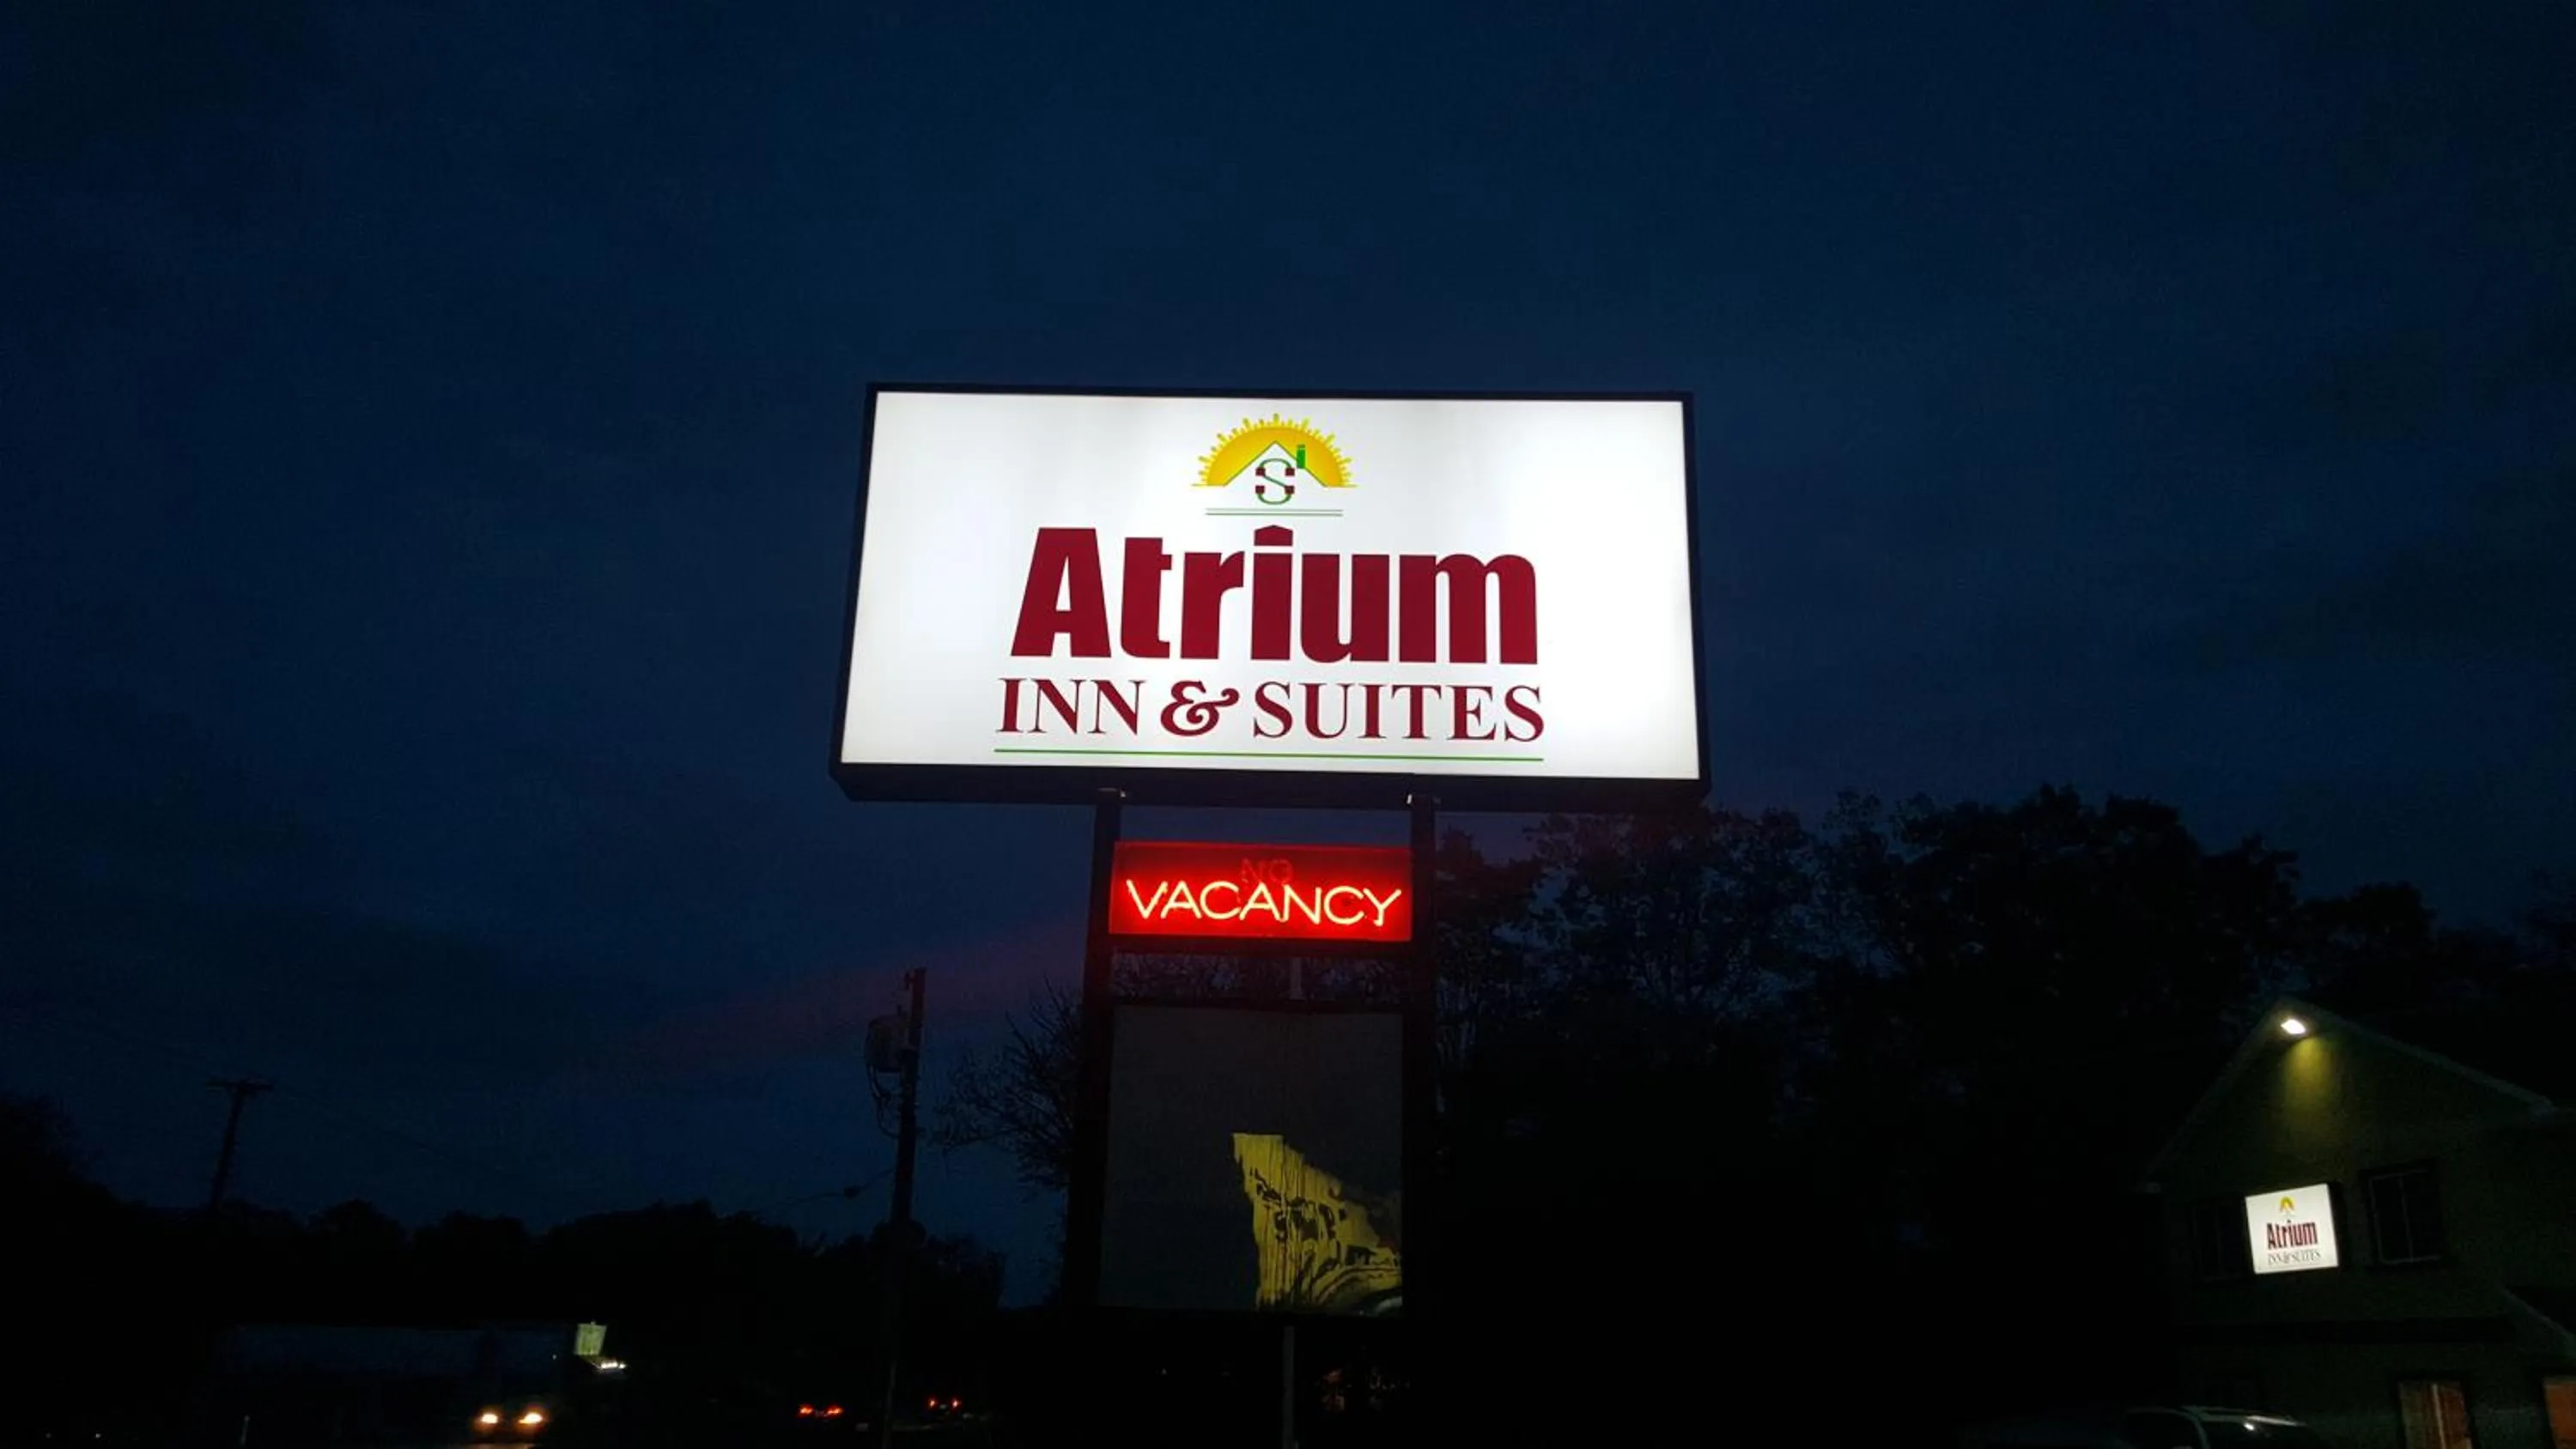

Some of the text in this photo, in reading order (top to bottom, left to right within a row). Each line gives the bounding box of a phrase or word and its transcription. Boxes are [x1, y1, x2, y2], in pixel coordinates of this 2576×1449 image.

[1011, 524, 1537, 664] Atrium
[999, 677, 1545, 742] INN & SUITES
[1126, 878, 1402, 926] VACANCY
[2266, 1219, 2318, 1250] Atrium
